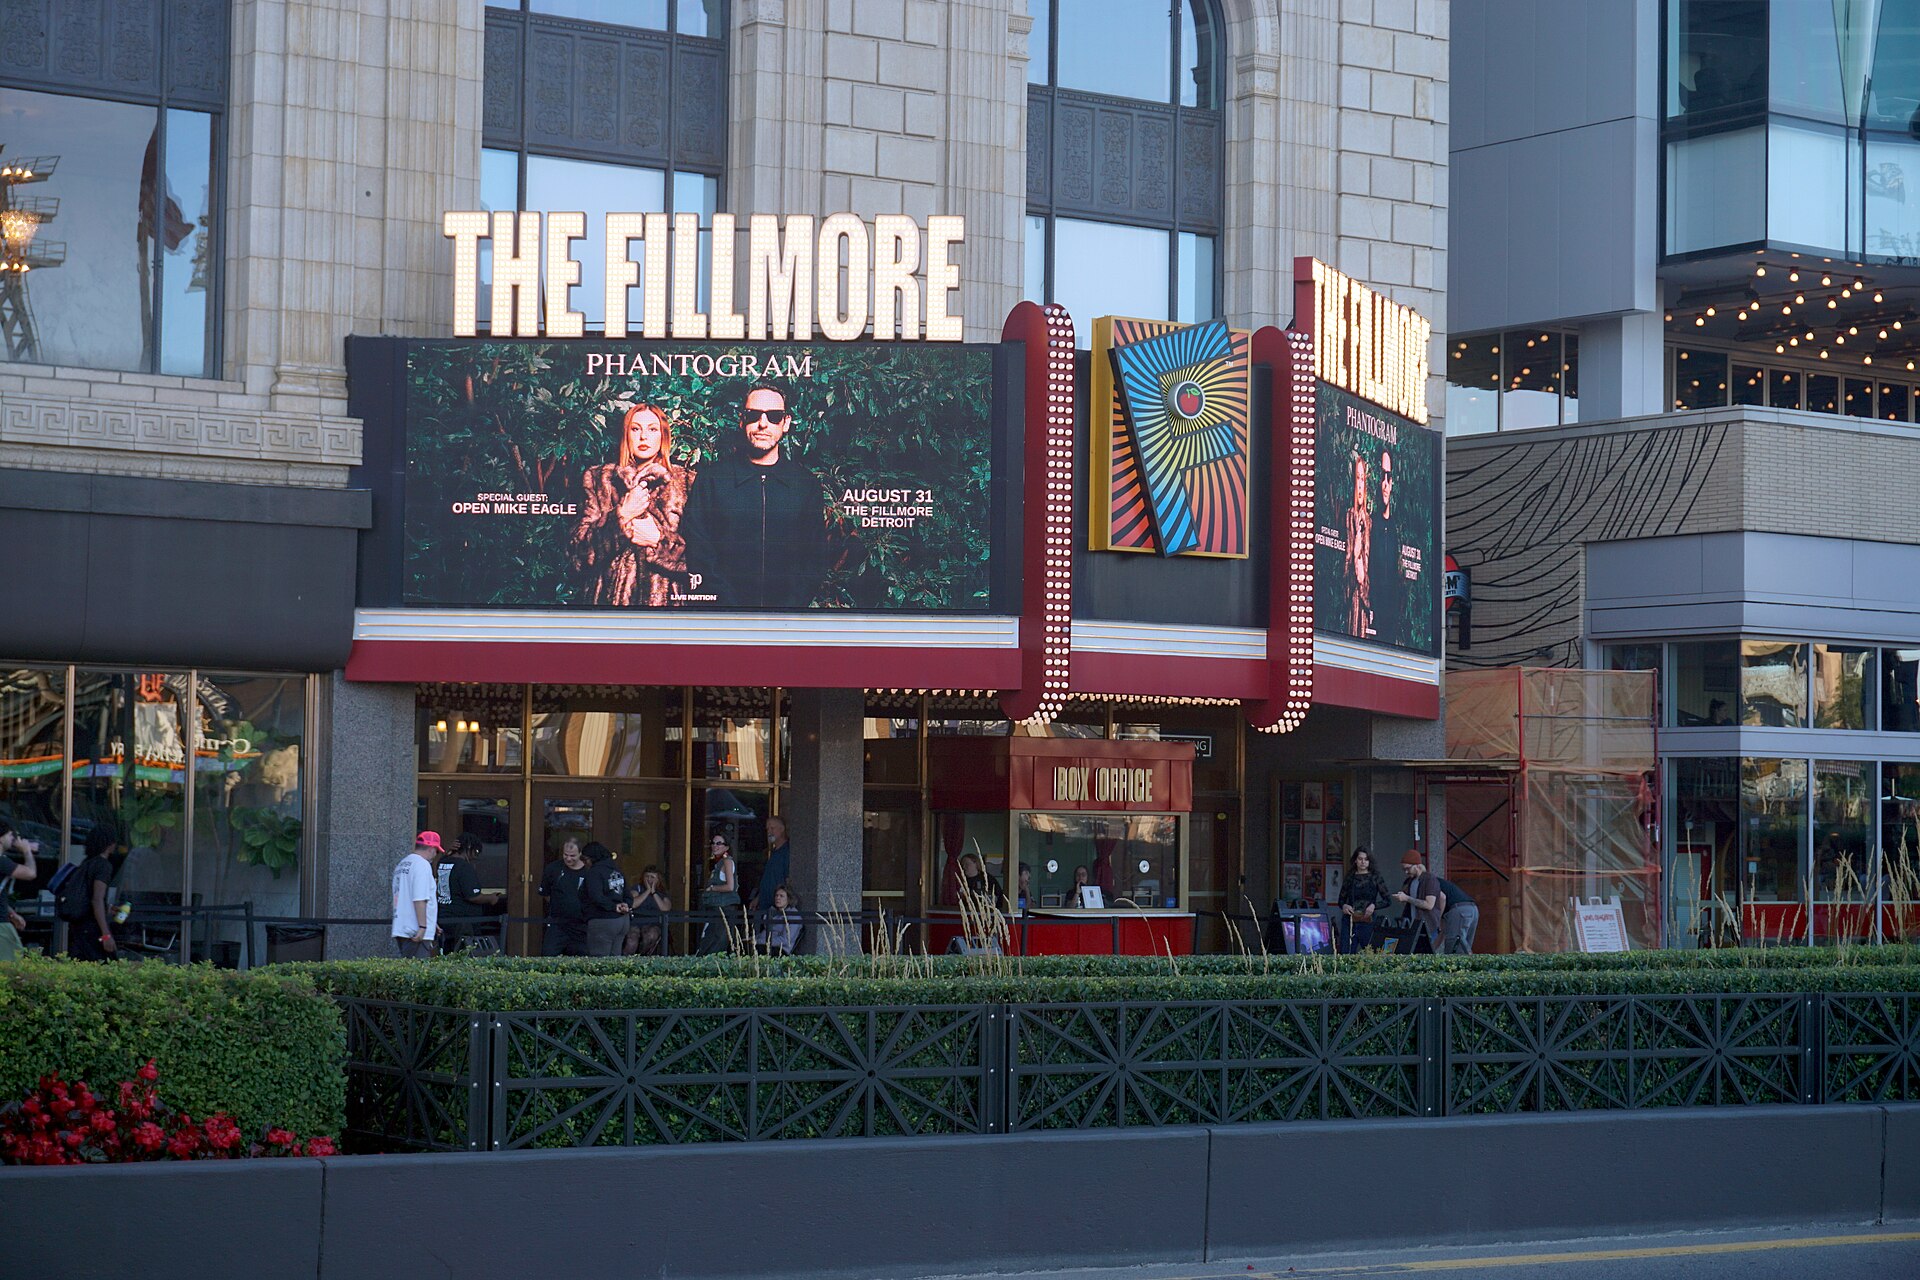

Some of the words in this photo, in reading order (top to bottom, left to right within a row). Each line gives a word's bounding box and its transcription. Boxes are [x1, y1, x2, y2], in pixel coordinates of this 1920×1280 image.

[443, 211, 587, 338] THE
[604, 212, 965, 341] FILLMORE
[586, 353, 813, 378] PHANTOGRAM
[1346, 405, 1397, 446] PHANTOGRAM
[477, 493, 515, 502] SPECIAL
[516, 494, 549, 503] GUEST:
[843, 489, 912, 503] AUGUST
[915, 489, 934, 503] 31
[452, 502, 490, 514] OPEN
[494, 503, 528, 515] MIKE
[531, 503, 577, 515] EAGLE
[844, 506, 868, 516] THE
[871, 506, 934, 517] FILLMORE
[861, 517, 915, 528] DETROIT
[1401, 544, 1417, 559] AUGUST
[1053, 766, 1090, 801] BOX
[1095, 767, 1153, 802] OFFICE
